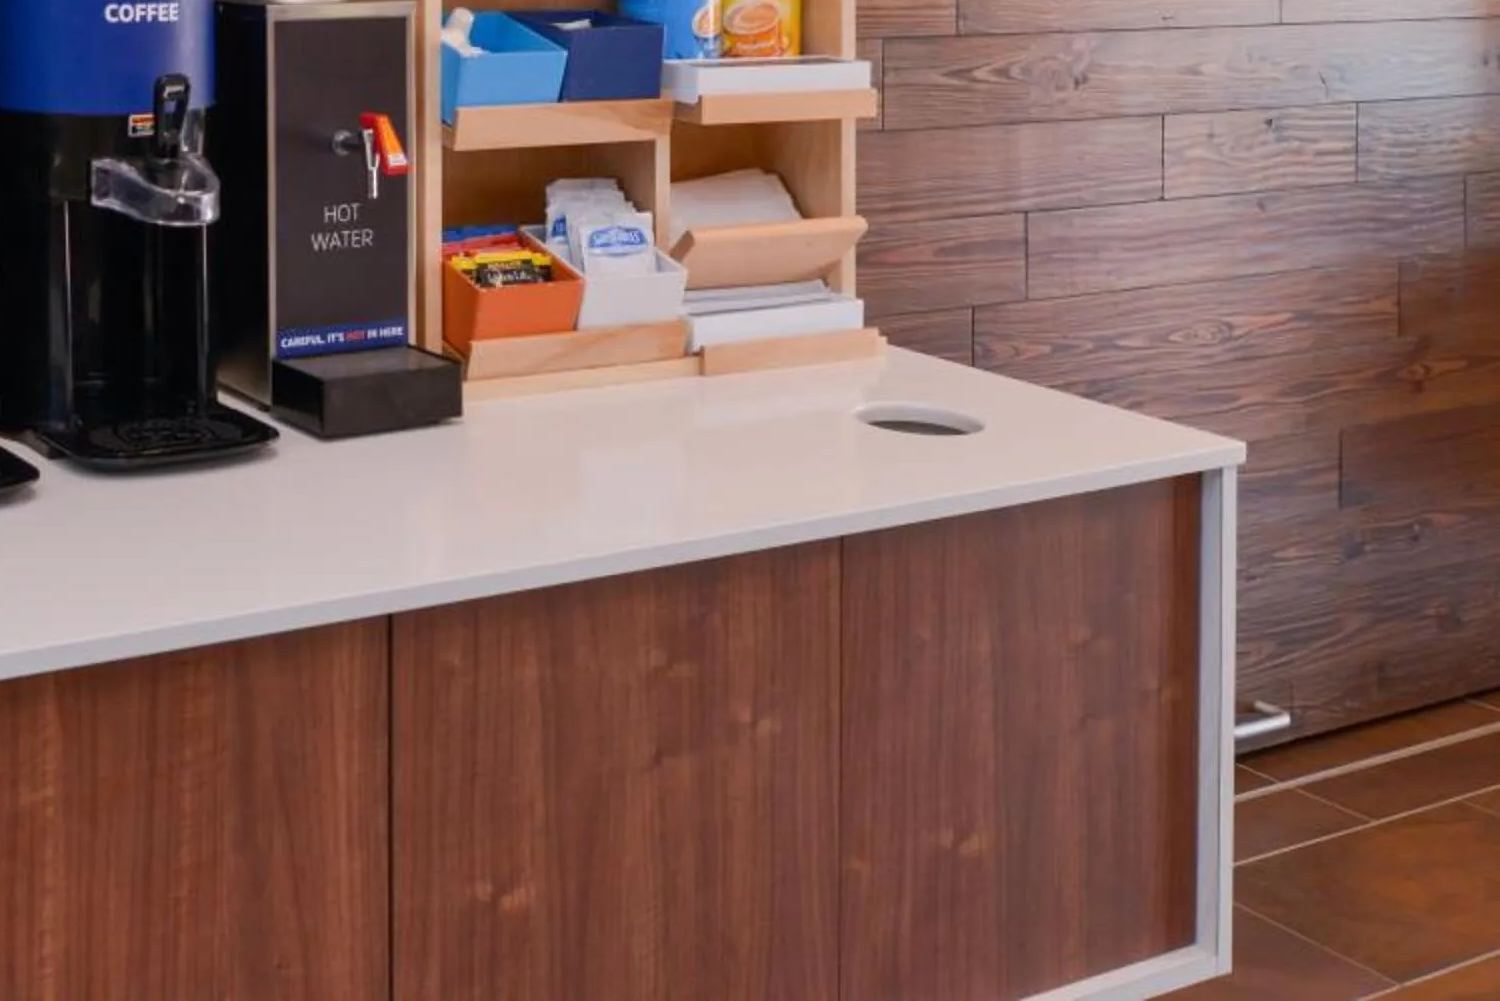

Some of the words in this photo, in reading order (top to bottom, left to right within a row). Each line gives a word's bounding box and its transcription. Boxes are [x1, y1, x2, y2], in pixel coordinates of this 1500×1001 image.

[104, 2, 180, 23] COFFEE
[323, 202, 362, 224] HOT
[311, 228, 374, 251] WATER
